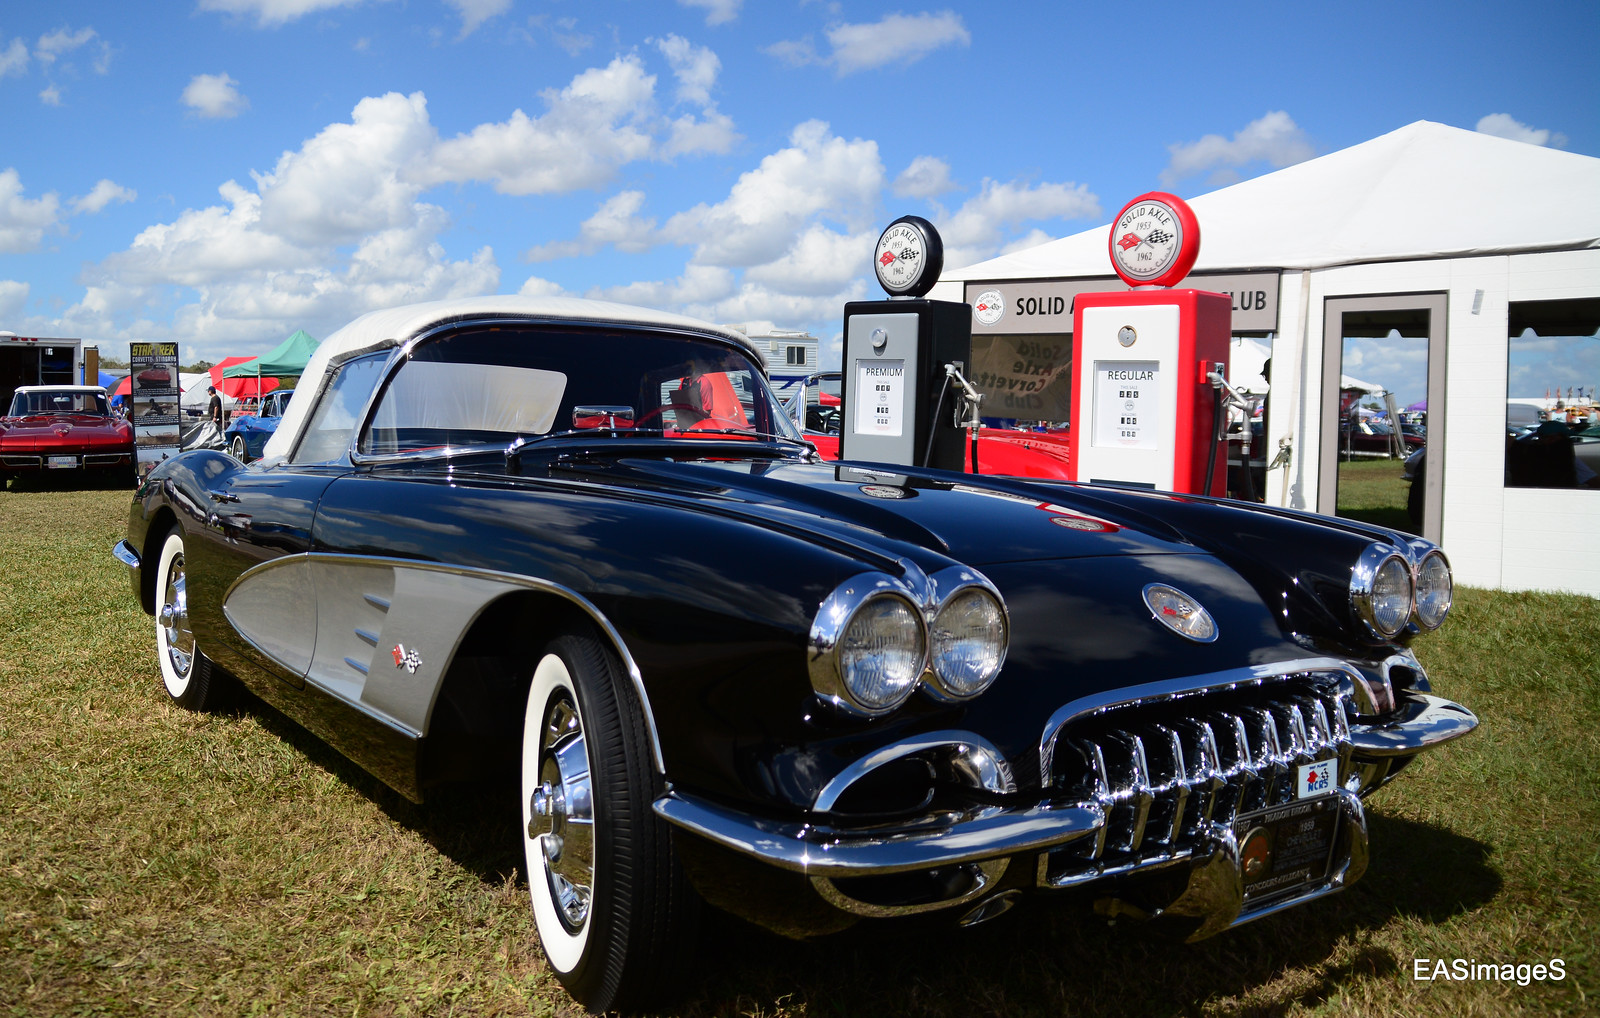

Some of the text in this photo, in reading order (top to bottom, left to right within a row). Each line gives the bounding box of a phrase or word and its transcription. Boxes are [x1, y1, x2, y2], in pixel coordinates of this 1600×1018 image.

[1122, 207, 1171, 229] SOLID AXLE
[1136, 221, 1152, 231] 1953
[882, 228, 917, 248] SOLID AXLE
[892, 241, 904, 250] 1953
[1137, 252, 1153, 262] 1962
[893, 266, 905, 276] 1962
[1223, 290, 1267, 311] LUB
[1016, 297, 1065, 316] SOLID
[132, 344, 176, 356] STAR TREK
[866, 367, 904, 377] PREMIUM
[1107, 370, 1155, 381] REGULAR
[1308, 779, 1329, 792] NCRS
